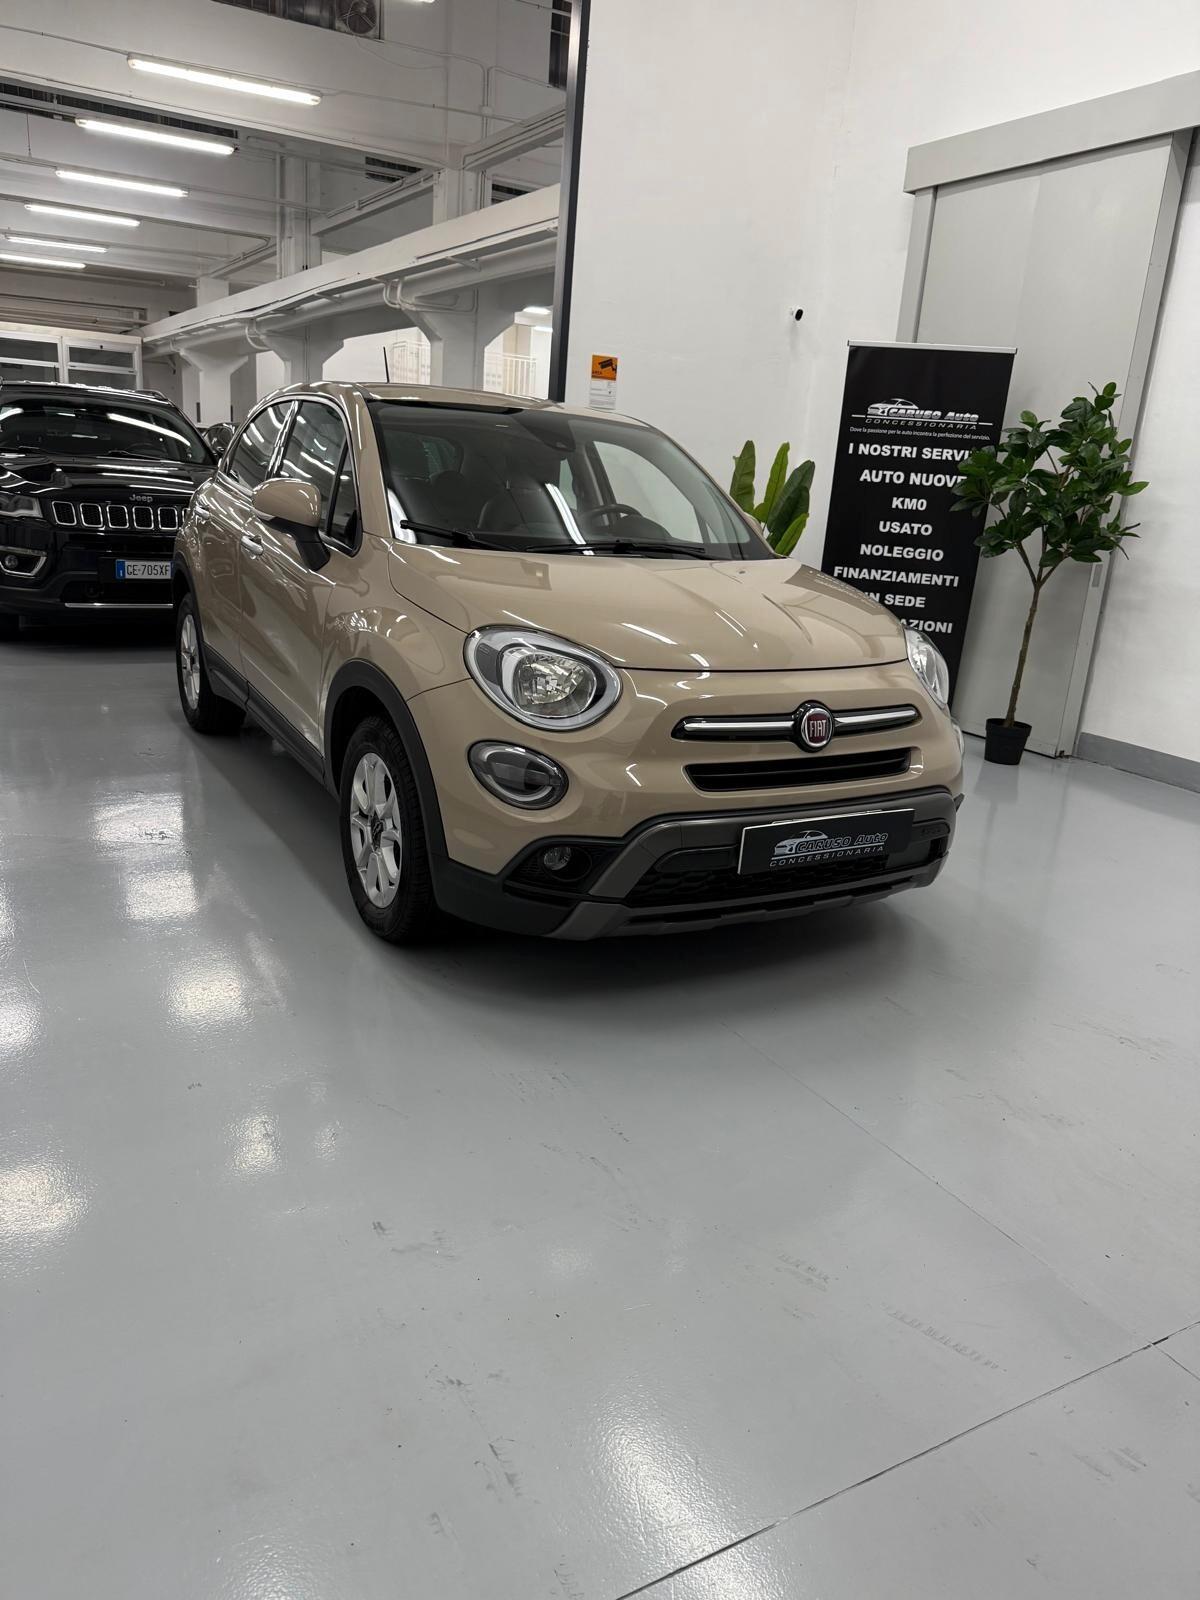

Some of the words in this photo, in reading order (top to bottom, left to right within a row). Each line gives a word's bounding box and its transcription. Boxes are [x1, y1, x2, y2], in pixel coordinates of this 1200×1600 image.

[888, 408, 942, 420] CARUSO
[944, 411, 979, 421] Auto
[865, 419, 977, 430] CONCESSIONARIA
[848, 442, 854, 454] I
[858, 443, 917, 458] NOSTRI
[921, 447, 972, 461] SERVI
[860, 469, 905, 484] AUTO
[129, 494, 153, 503] Jeep
[878, 521, 933, 536] USATO
[860, 544, 944, 562] NOLEGGIO
[833, 566, 960, 587] FINANZIAMENTI
[884, 593, 926, 608] SEDE
[809, 719, 827, 738] FIAT
[797, 836, 851, 853] CARUSO
[854, 832, 889, 846] Auto
[769, 846, 884, 867] CONCESSIONARIA
